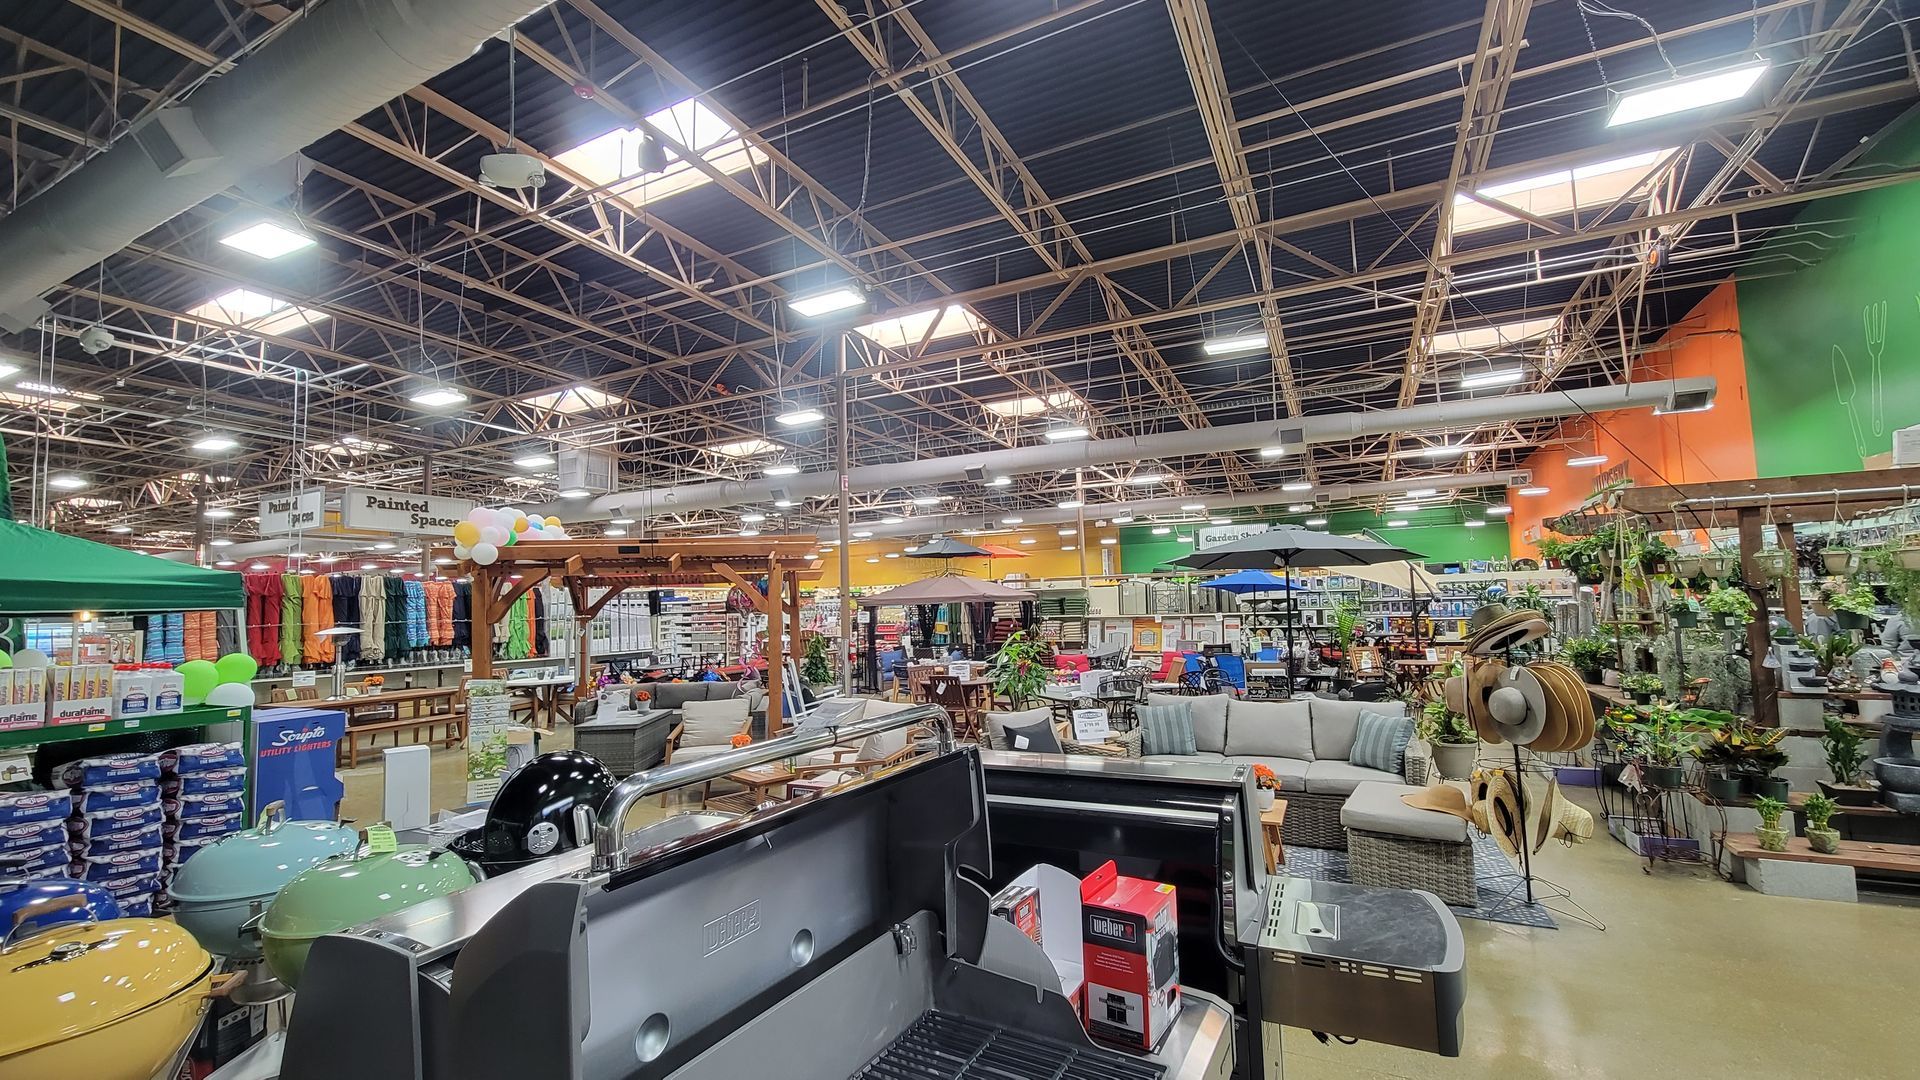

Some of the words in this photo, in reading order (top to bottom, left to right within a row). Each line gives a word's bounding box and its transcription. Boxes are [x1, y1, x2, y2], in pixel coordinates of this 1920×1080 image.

[268, 497, 298, 513] Paintd
[366, 496, 429, 512] Painted
[1205, 534, 1239, 542] Garden
[60, 706, 105, 718] duraflame
[272, 726, 325, 746] Scripto
[260, 747, 292, 757] UTILITY
[294, 740, 333, 752] LIGHTERS
[1093, 918, 1124, 938] weber
